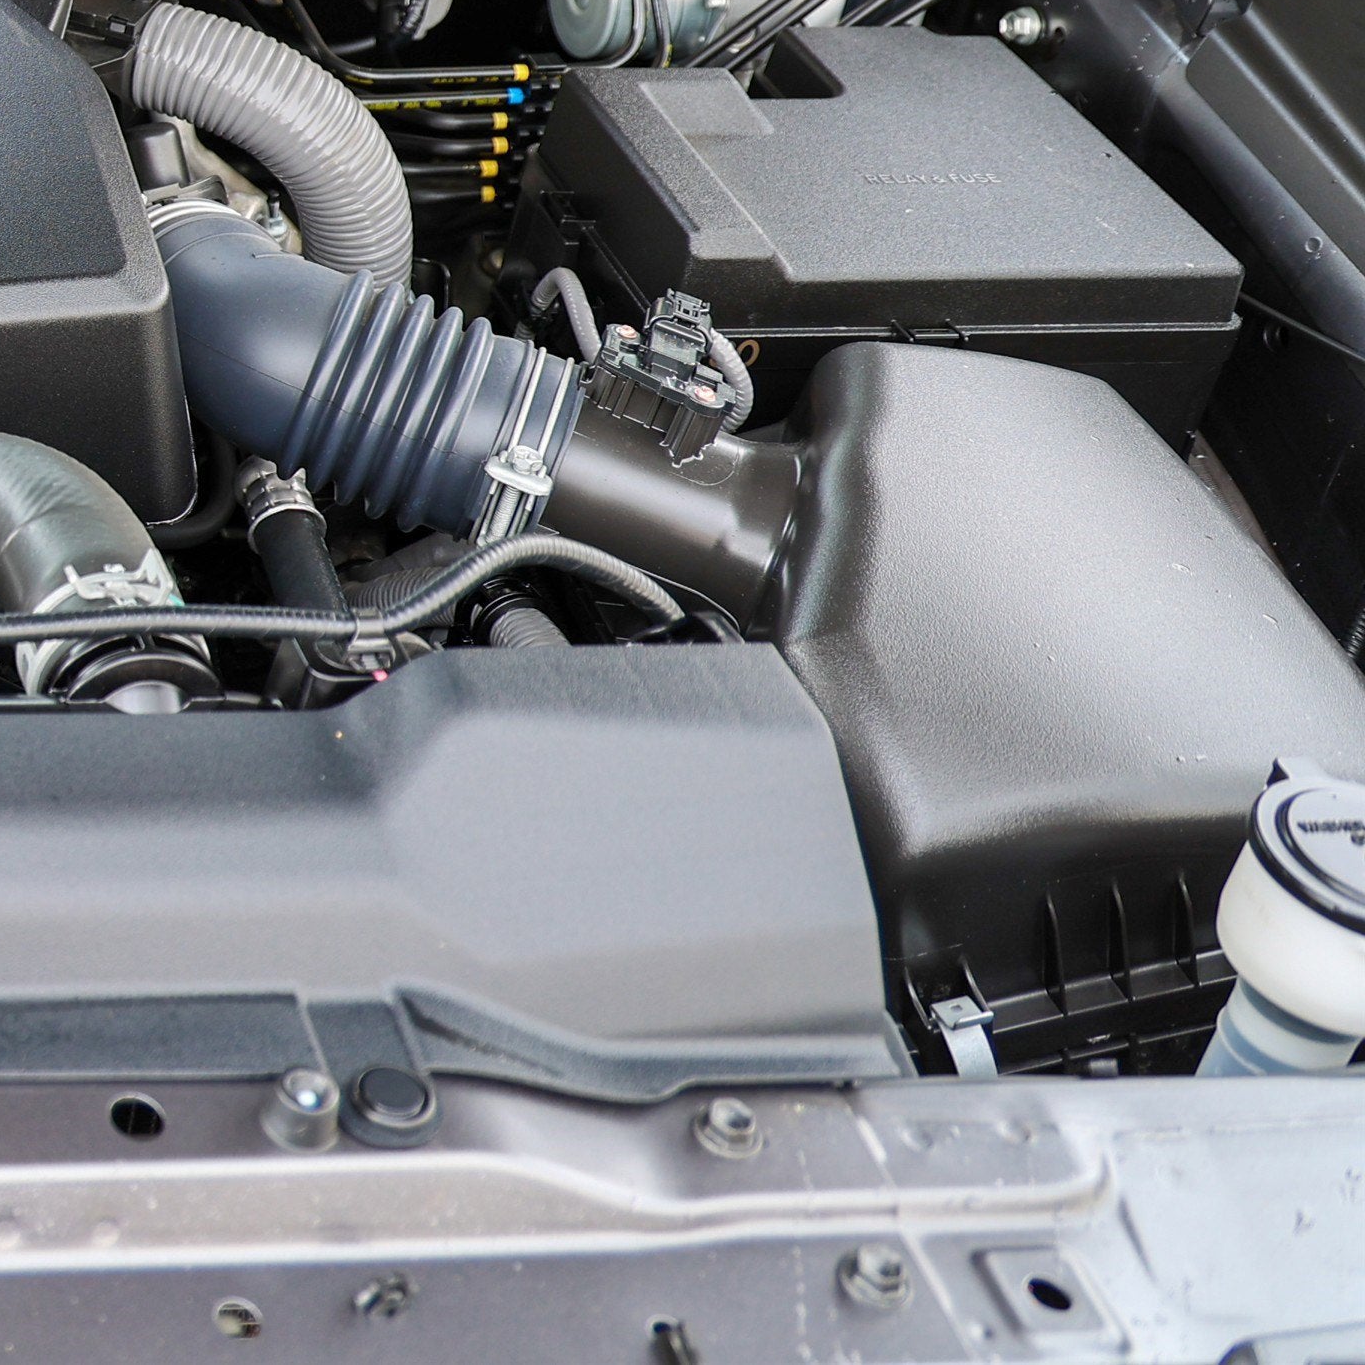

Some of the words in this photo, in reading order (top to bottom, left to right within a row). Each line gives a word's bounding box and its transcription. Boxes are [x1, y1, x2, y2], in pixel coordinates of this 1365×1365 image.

[864, 173, 928, 185] RELAY
[931, 175, 947, 184] &
[948, 172, 1002, 184] FUSE
